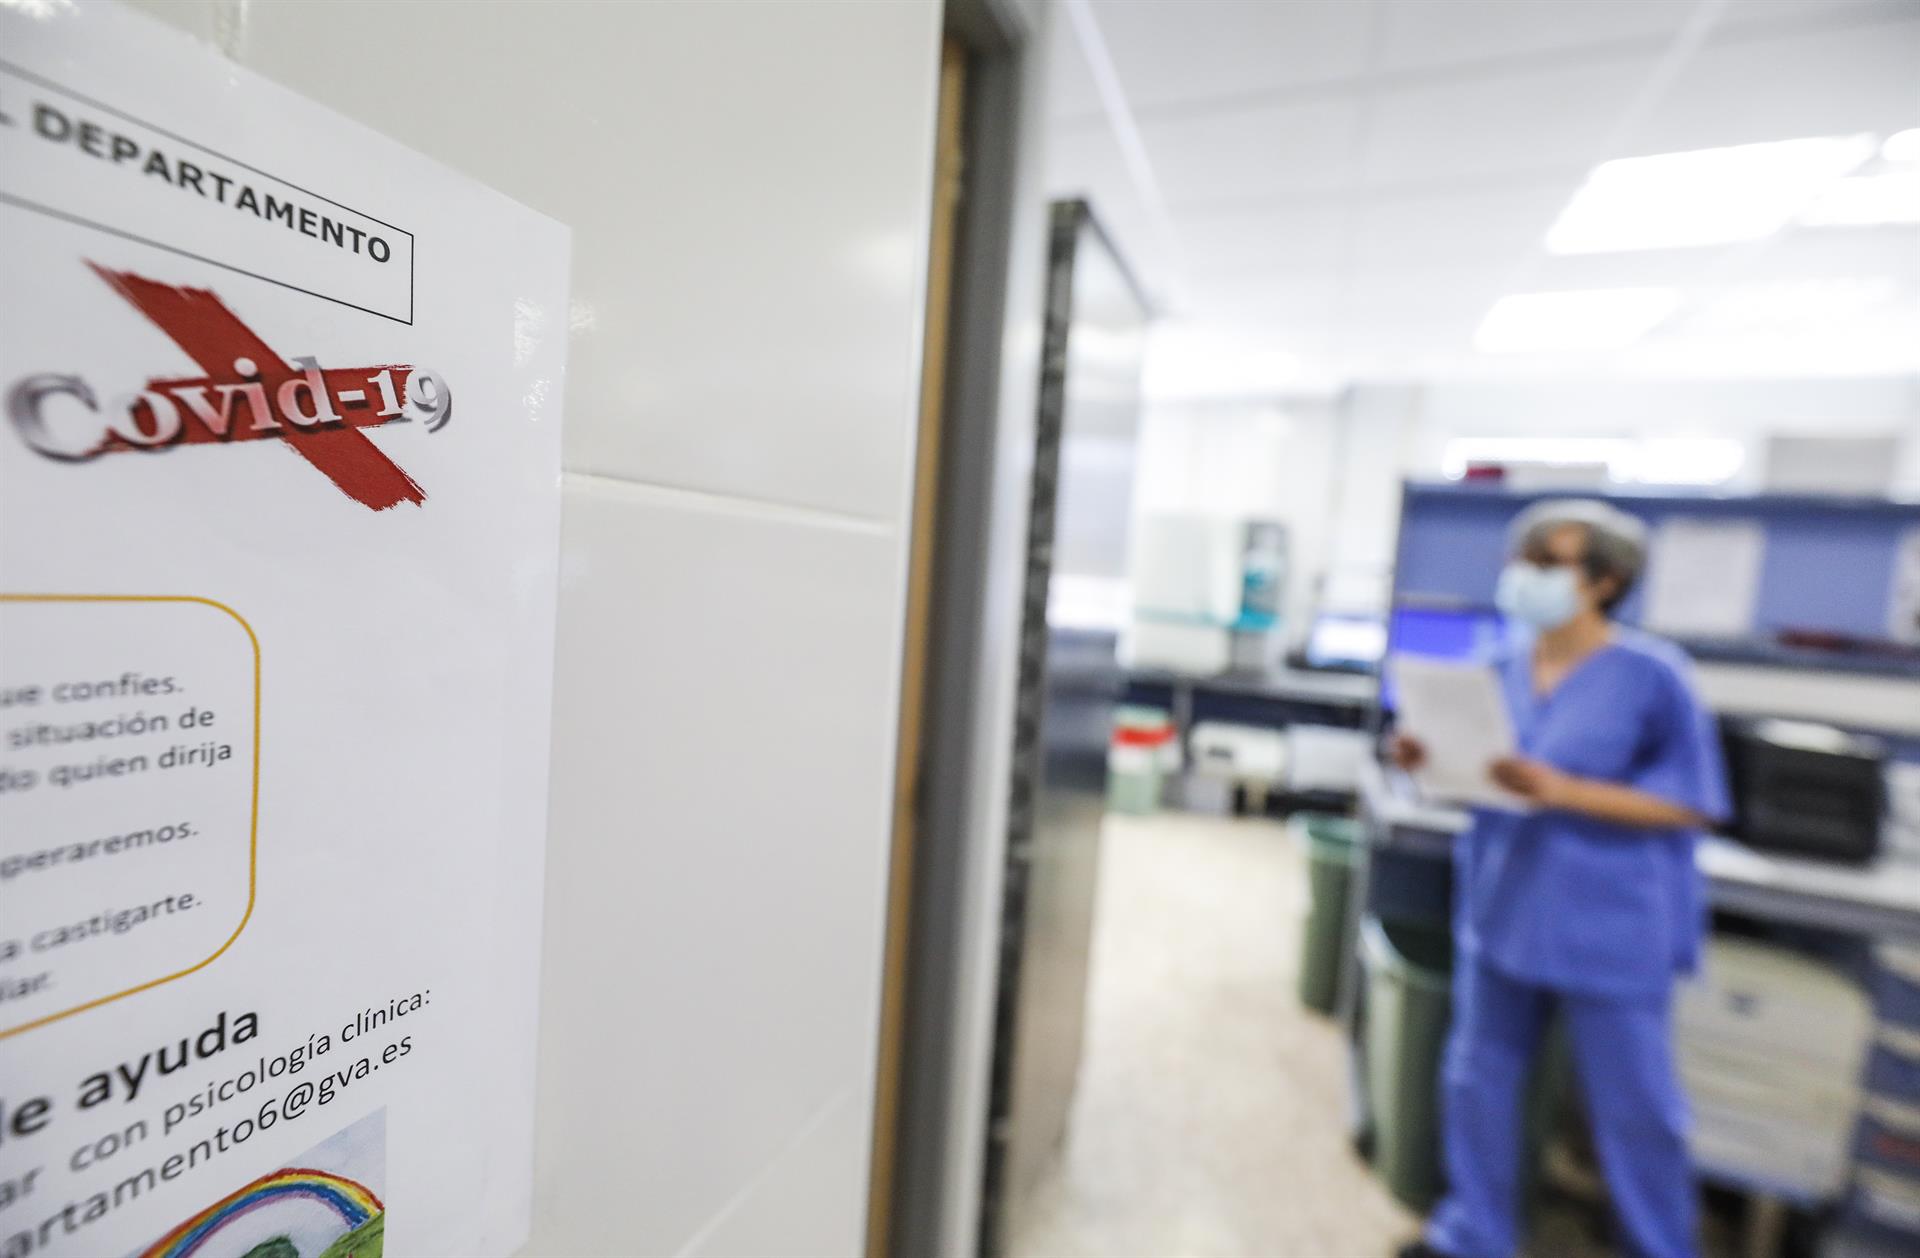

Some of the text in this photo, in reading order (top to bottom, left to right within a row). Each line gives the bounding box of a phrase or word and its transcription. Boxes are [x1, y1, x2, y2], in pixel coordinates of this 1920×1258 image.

[32, 102, 391, 264] DEPARTAMENTO
[4, 356, 452, 464] Covid-19
[7, 706, 215, 749] situación de
[48, 755, 148, 790] quien
[157, 742, 232, 767] dirija
[30, 892, 202, 952] castigarte.
[69, 1119, 148, 1173] con
[163, 1033, 331, 1136] psicología
[341, 989, 430, 1042] clínica:
[76, 1011, 258, 1110] ayuda
